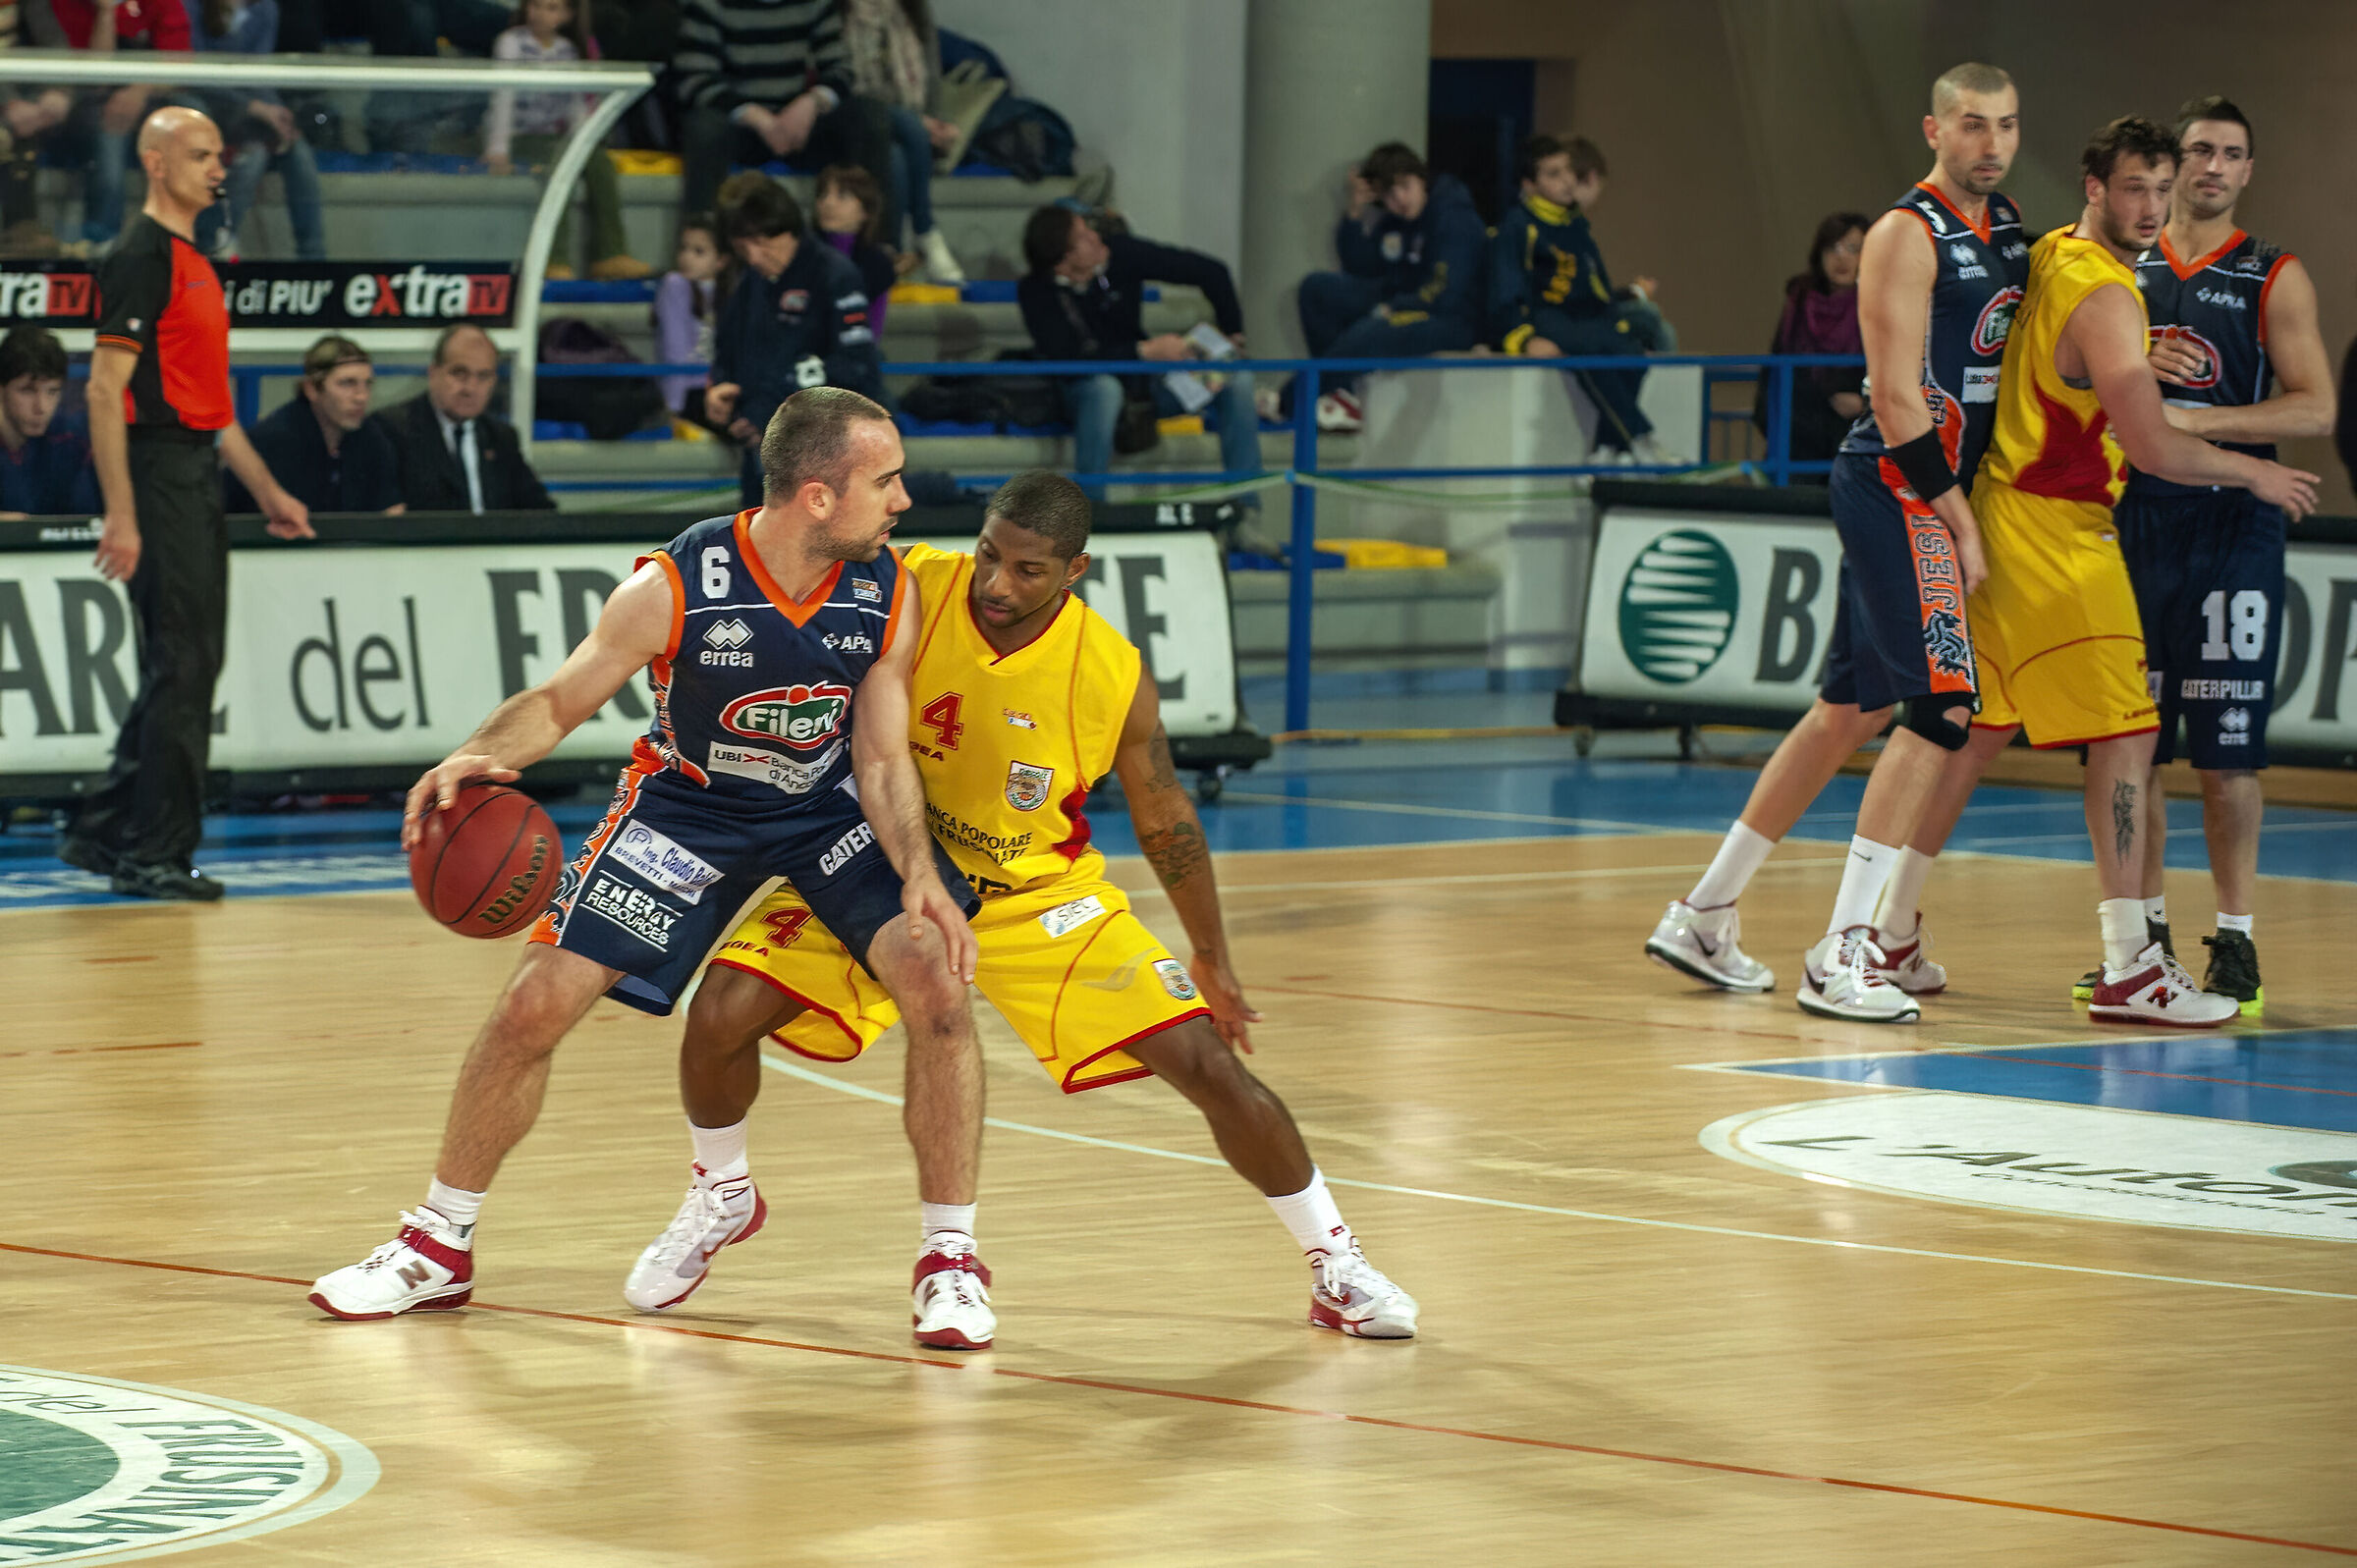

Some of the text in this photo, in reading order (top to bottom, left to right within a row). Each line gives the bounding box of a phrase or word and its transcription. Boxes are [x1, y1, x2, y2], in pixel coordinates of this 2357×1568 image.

[701, 546, 731, 599] 6
[1910, 514, 1958, 611] JESI
[2201, 590, 2268, 661] 18
[291, 596, 431, 732] del
[746, 699, 840, 738] Fileni
[919, 691, 964, 751] 4
[715, 749, 741, 763] UBI
[771, 757, 809, 780] Banca
[926, 802, 1033, 849] ANCA POPOLARE
[478, 835, 550, 924] Wilson
[615, 846, 665, 881] BREVETTI
[661, 846, 695, 882] Claudio
[584, 891, 670, 946] RESOURCES
[592, 878, 676, 931] ENERGY
[759, 906, 814, 948] 4
[0, 1419, 304, 1563] FRUSINAT
